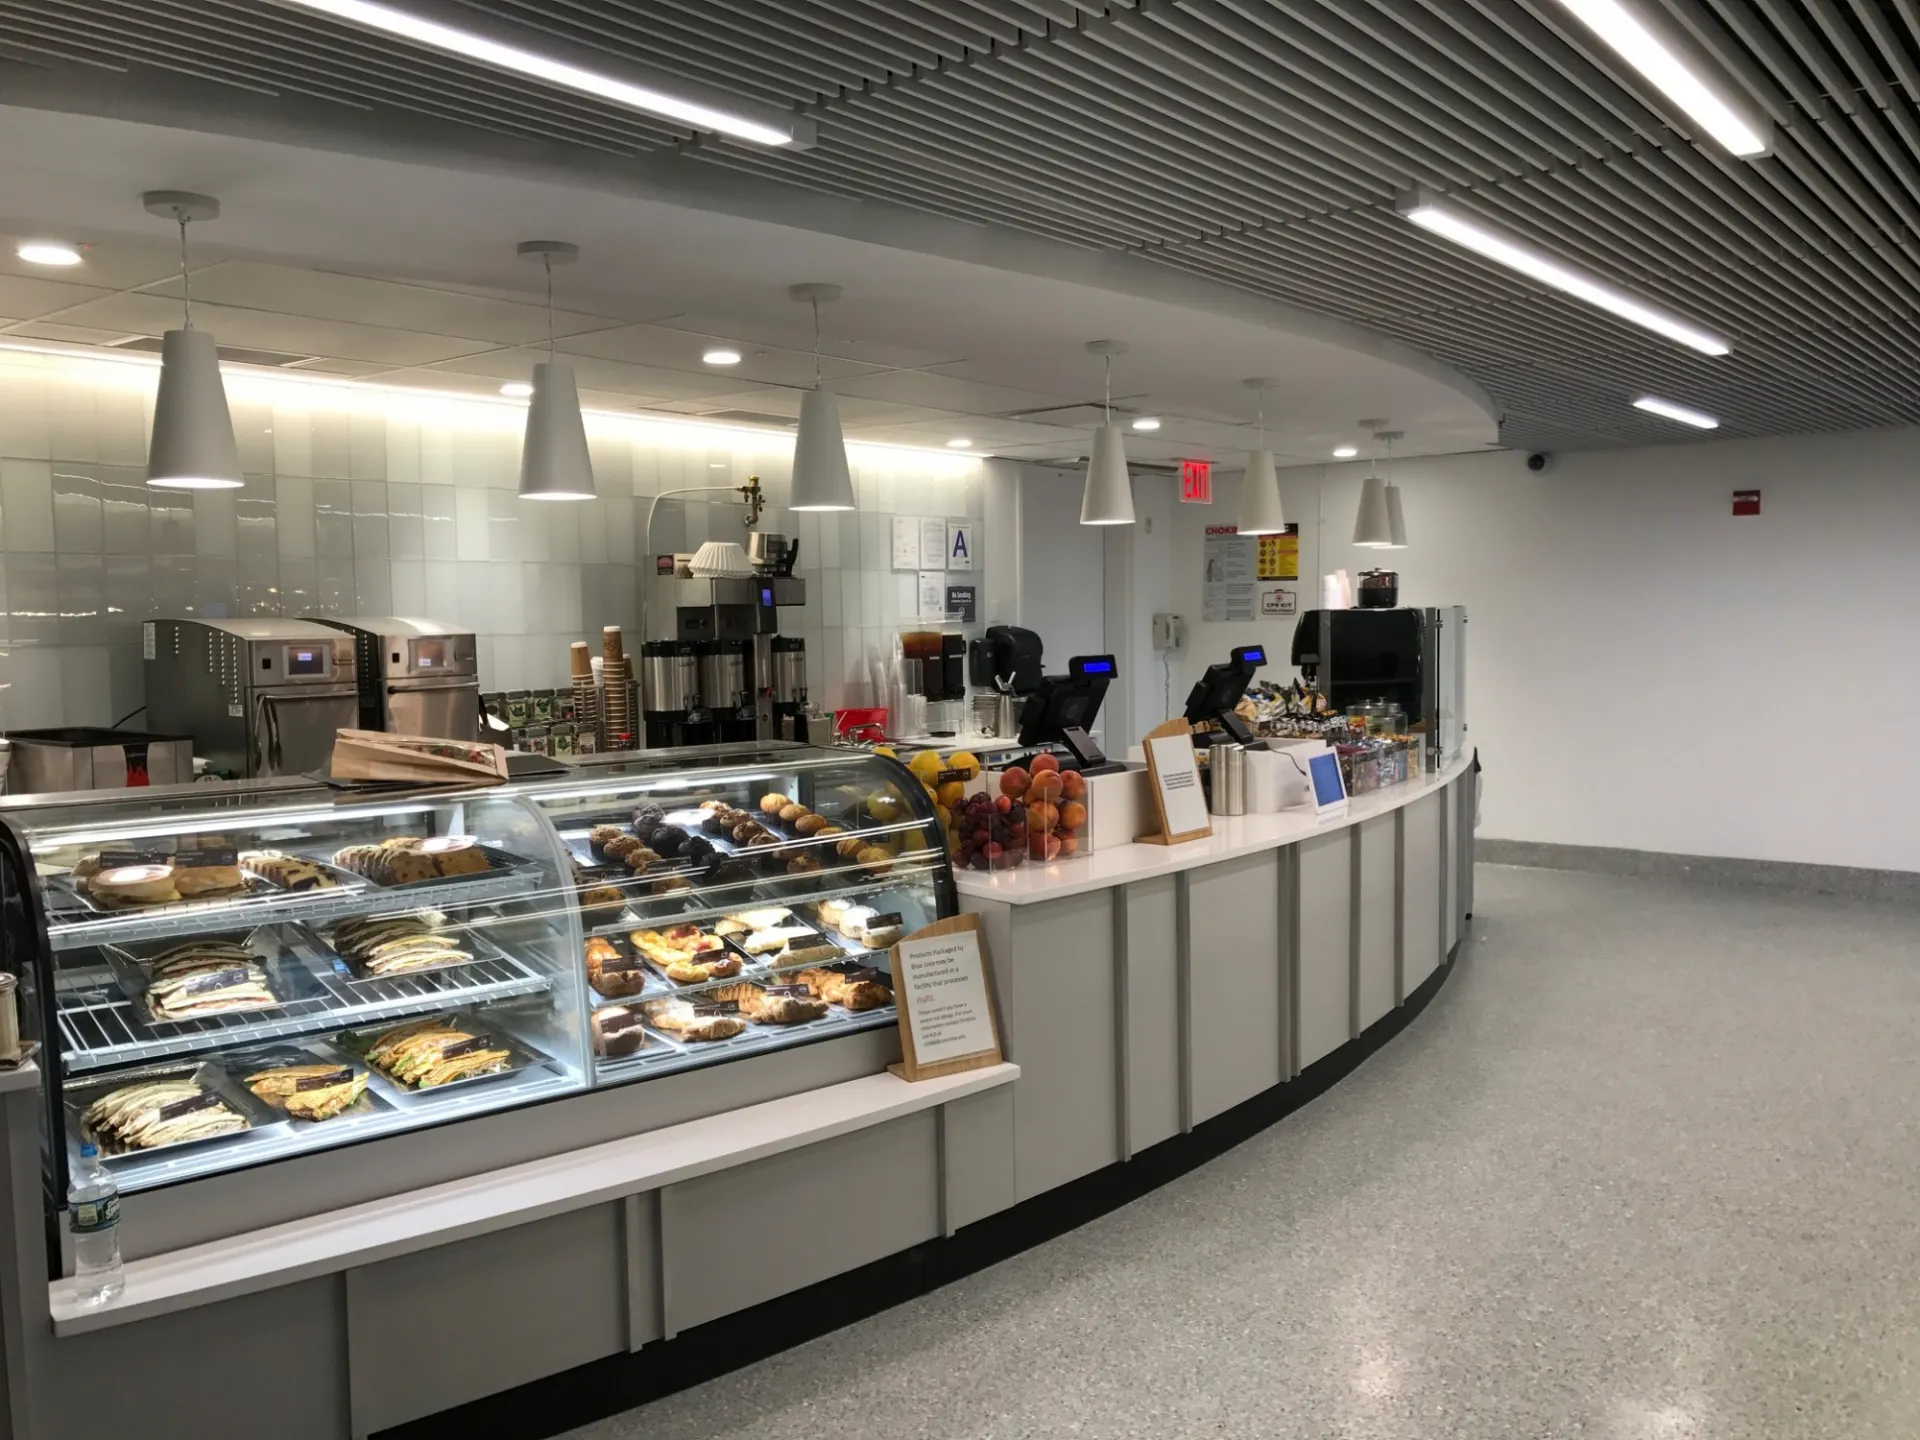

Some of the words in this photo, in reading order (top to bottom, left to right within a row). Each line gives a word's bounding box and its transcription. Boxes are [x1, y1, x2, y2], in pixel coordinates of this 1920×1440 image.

[1184, 462, 1210, 499] EXIT
[952, 530, 968, 558] A
[909, 951, 932, 959] Products
[932, 946, 956, 956] Packaged
[912, 968, 949, 980] manufactured
[914, 982, 932, 990] facility
[943, 975, 969, 986] processes
